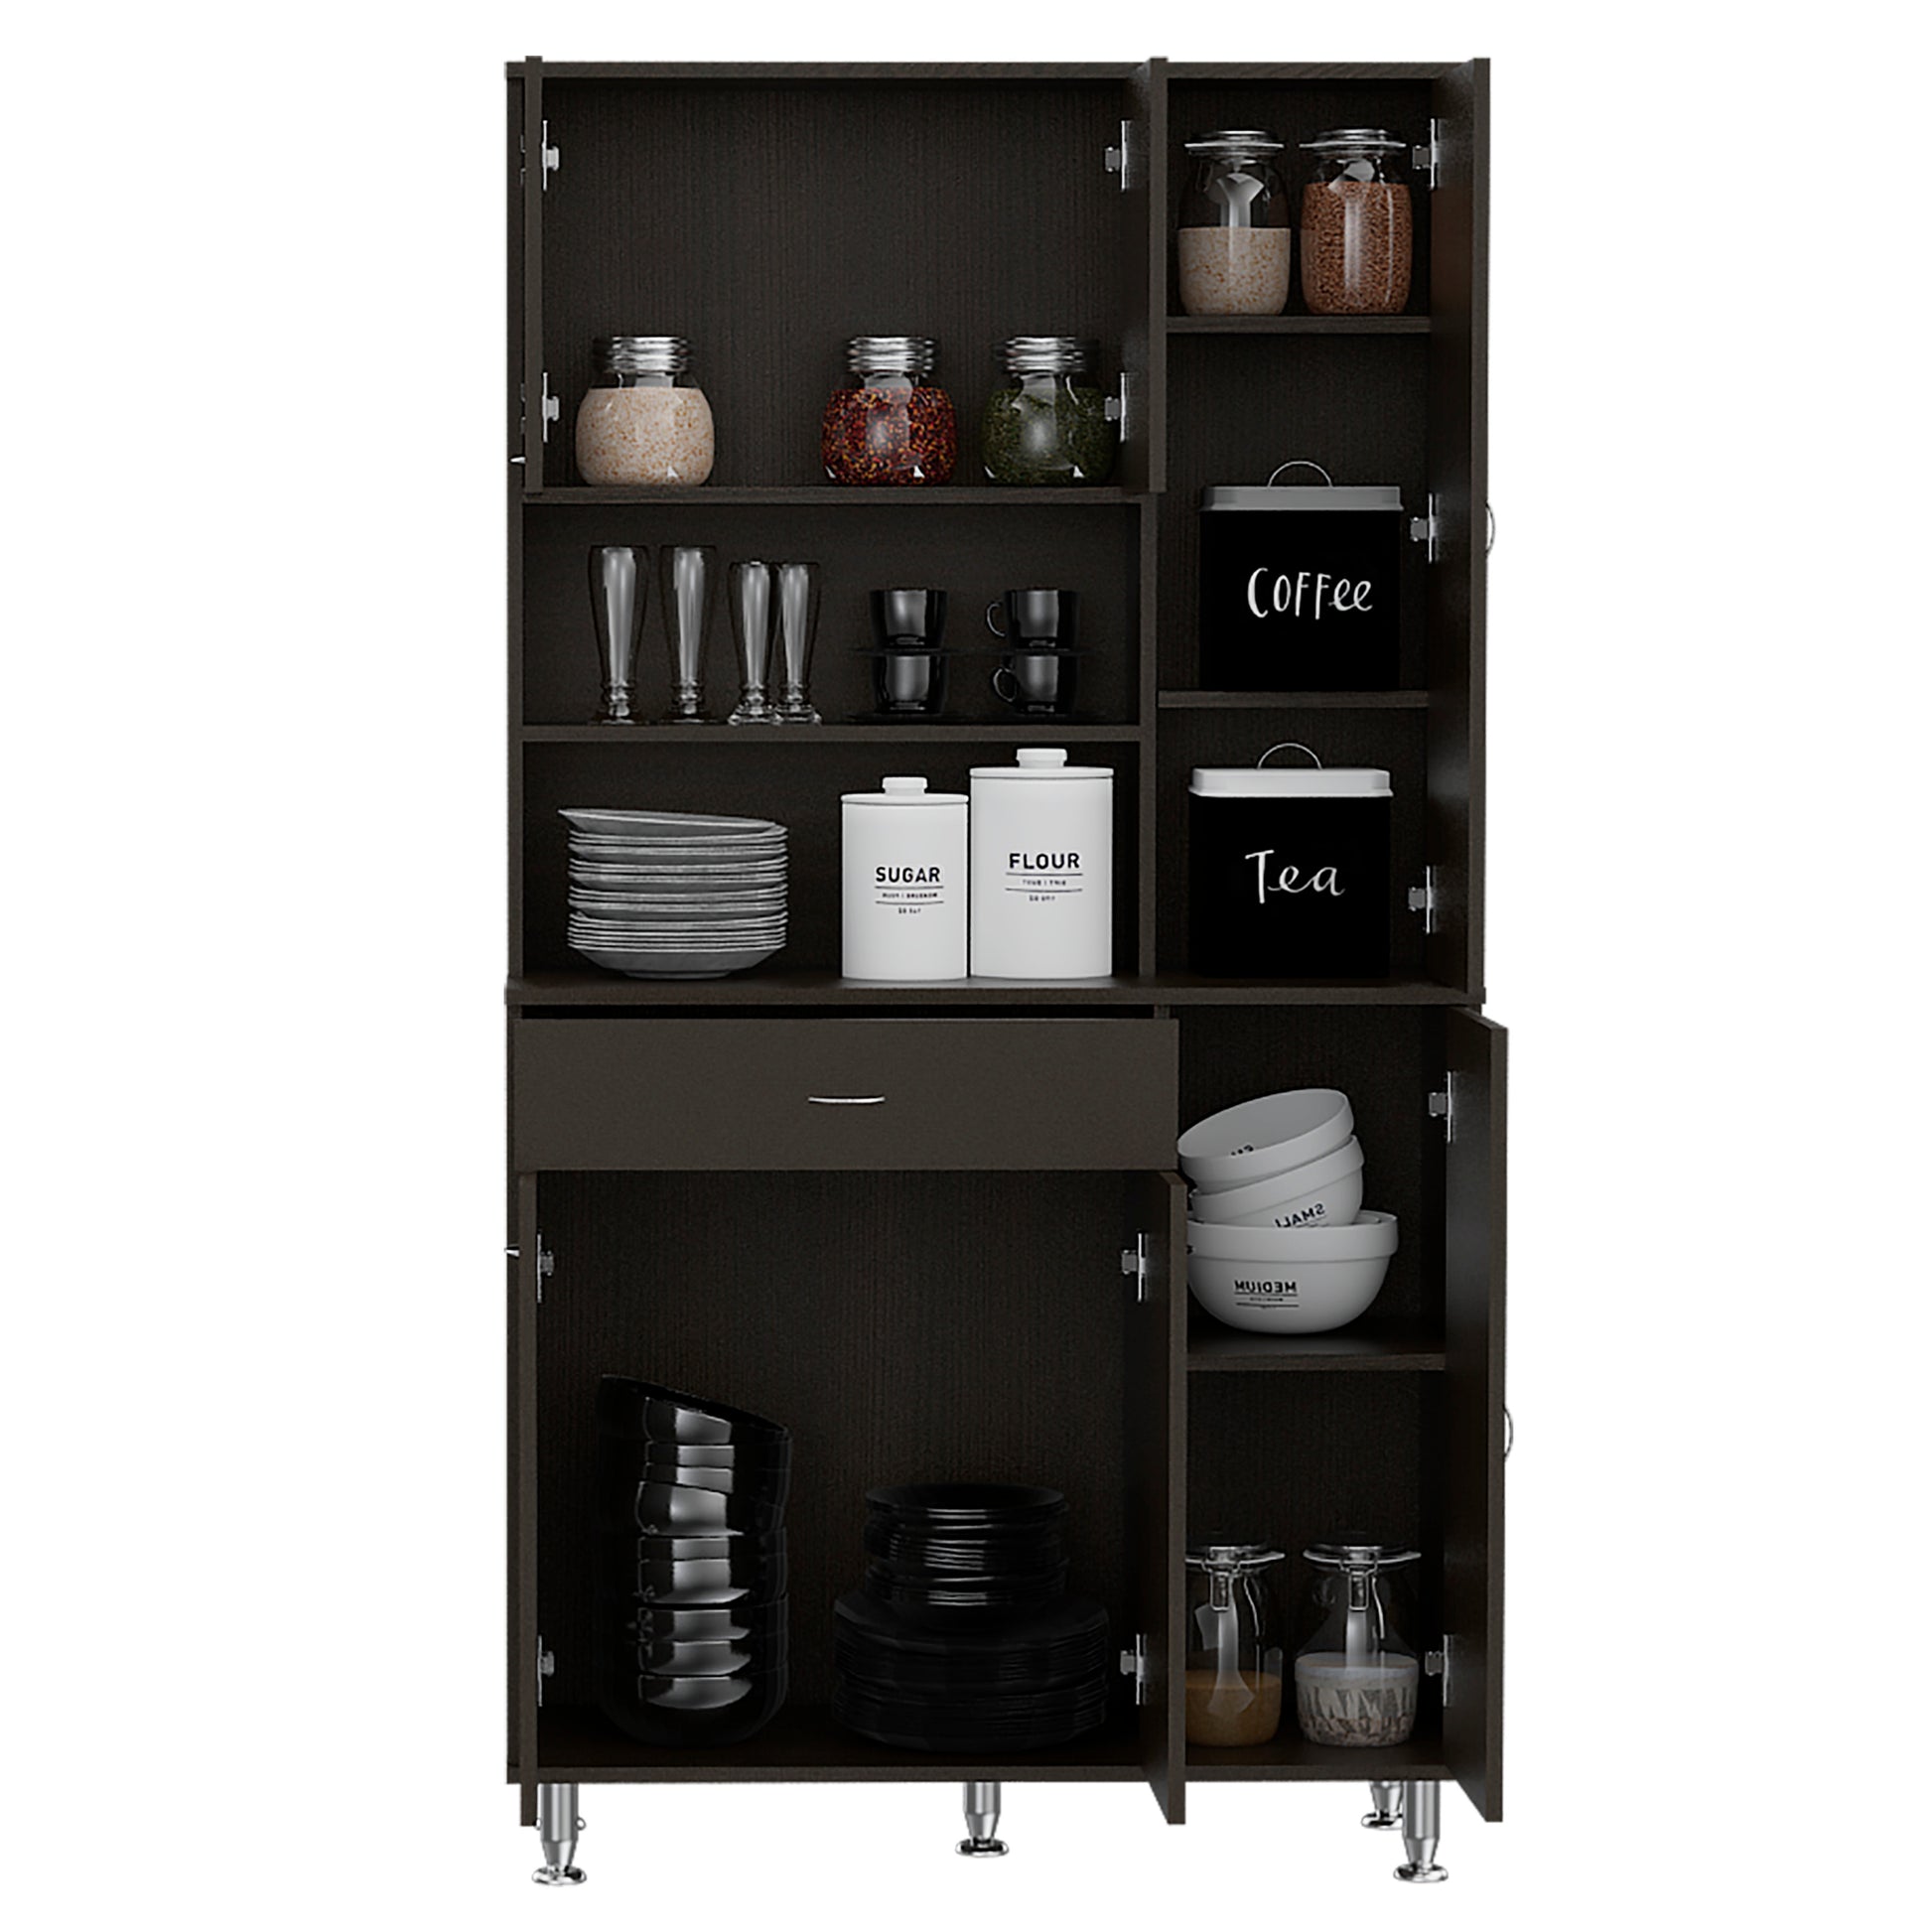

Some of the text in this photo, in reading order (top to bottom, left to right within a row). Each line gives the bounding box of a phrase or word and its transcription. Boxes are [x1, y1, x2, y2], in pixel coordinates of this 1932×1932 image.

[1009, 852, 1080, 870] FLOUR
[876, 866, 941, 884] SUGAR
[1245, 849, 1345, 904] Tea
